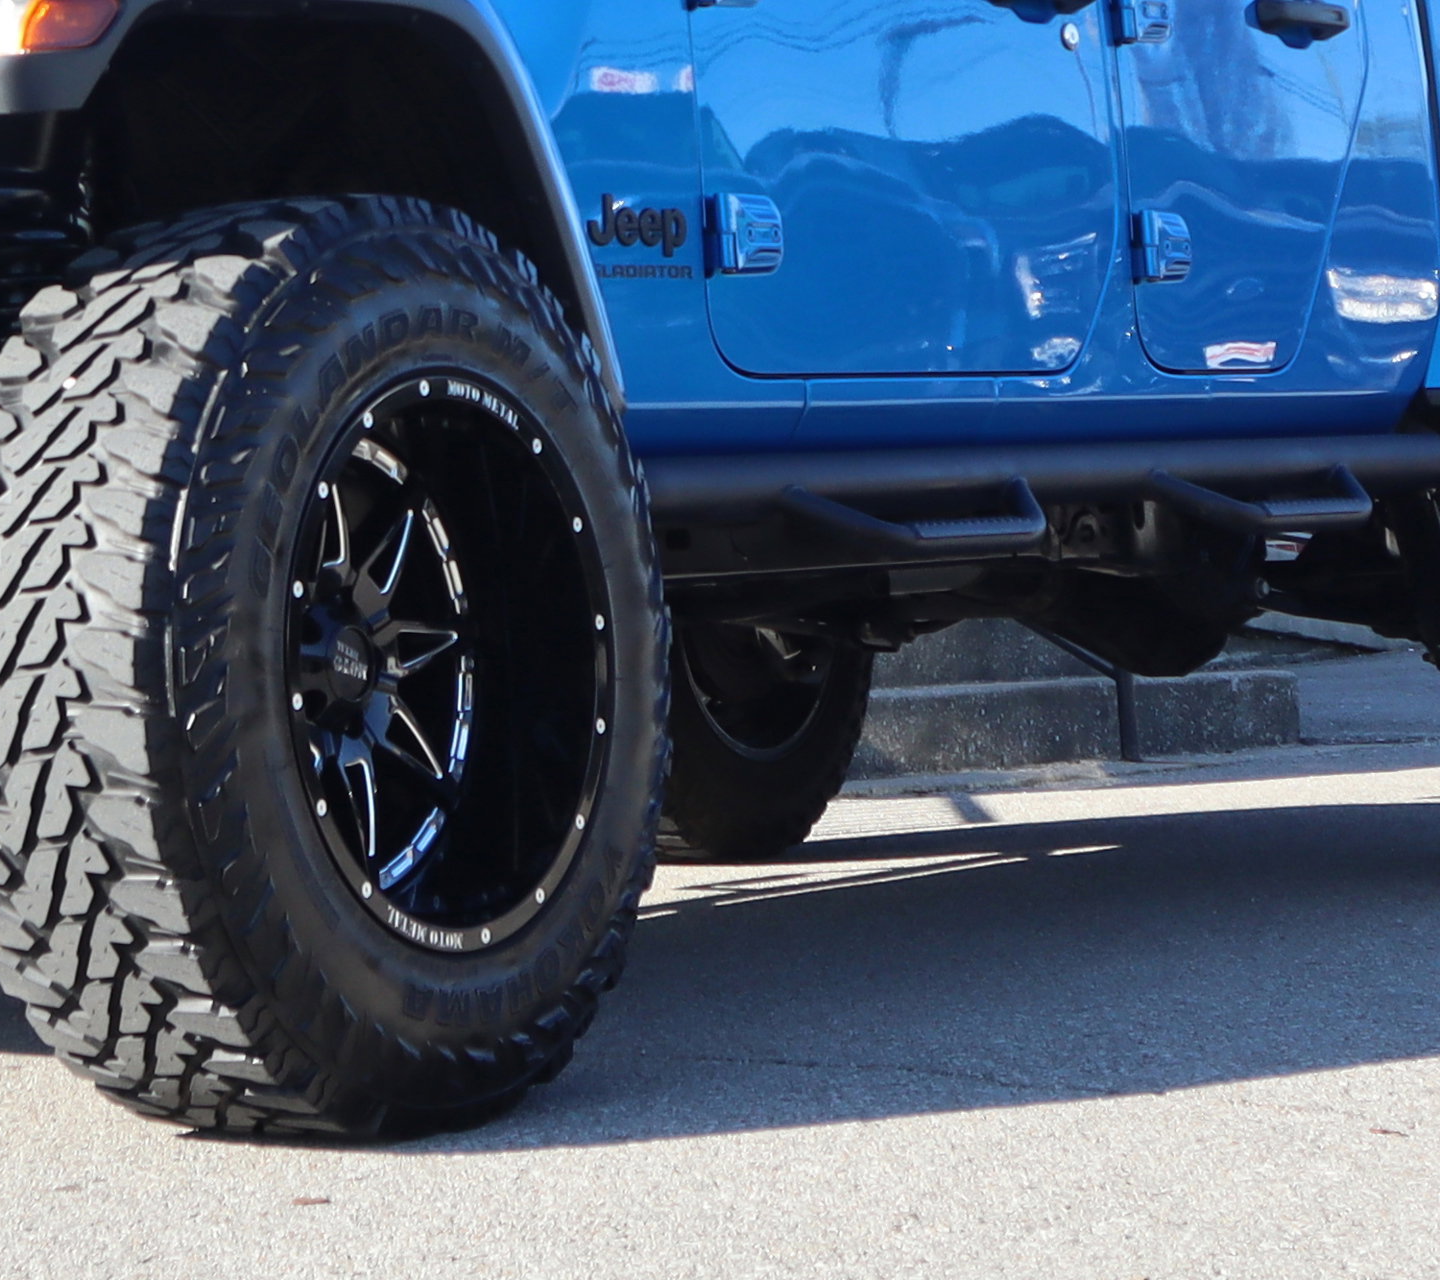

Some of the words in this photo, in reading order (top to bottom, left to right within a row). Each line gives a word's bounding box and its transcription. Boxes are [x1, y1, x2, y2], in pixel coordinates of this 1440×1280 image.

[586, 192, 687, 258] Jeep
[447, 379, 481, 402] MOTO
[482, 391, 519, 431] METAL
[387, 904, 428, 944] METAL
[429, 930, 464, 950] MOTO
